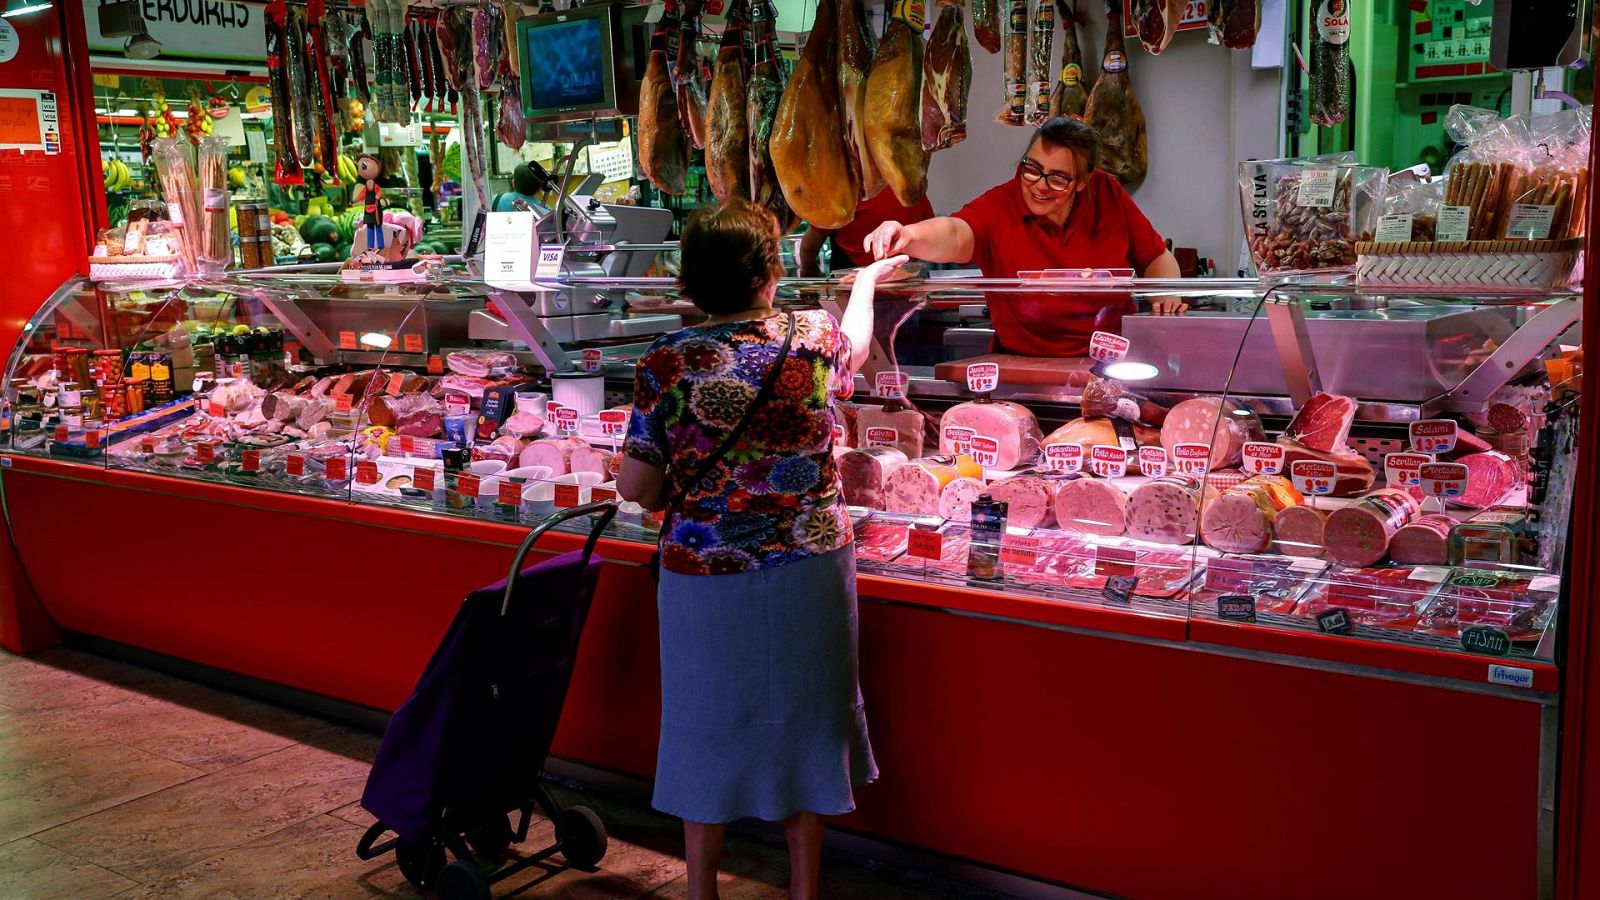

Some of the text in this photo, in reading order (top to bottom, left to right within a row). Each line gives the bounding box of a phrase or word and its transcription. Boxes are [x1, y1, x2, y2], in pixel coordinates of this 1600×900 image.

[1255, 222, 1268, 237] LA
[543, 252, 559, 262] VISA
[1415, 424, 1449, 434] Salami
[1094, 448, 1109, 457] Pollo
[1248, 445, 1279, 454] Chopped
[1424, 466, 1465, 475] Mortadela
[1467, 629, 1504, 652] FISAN
